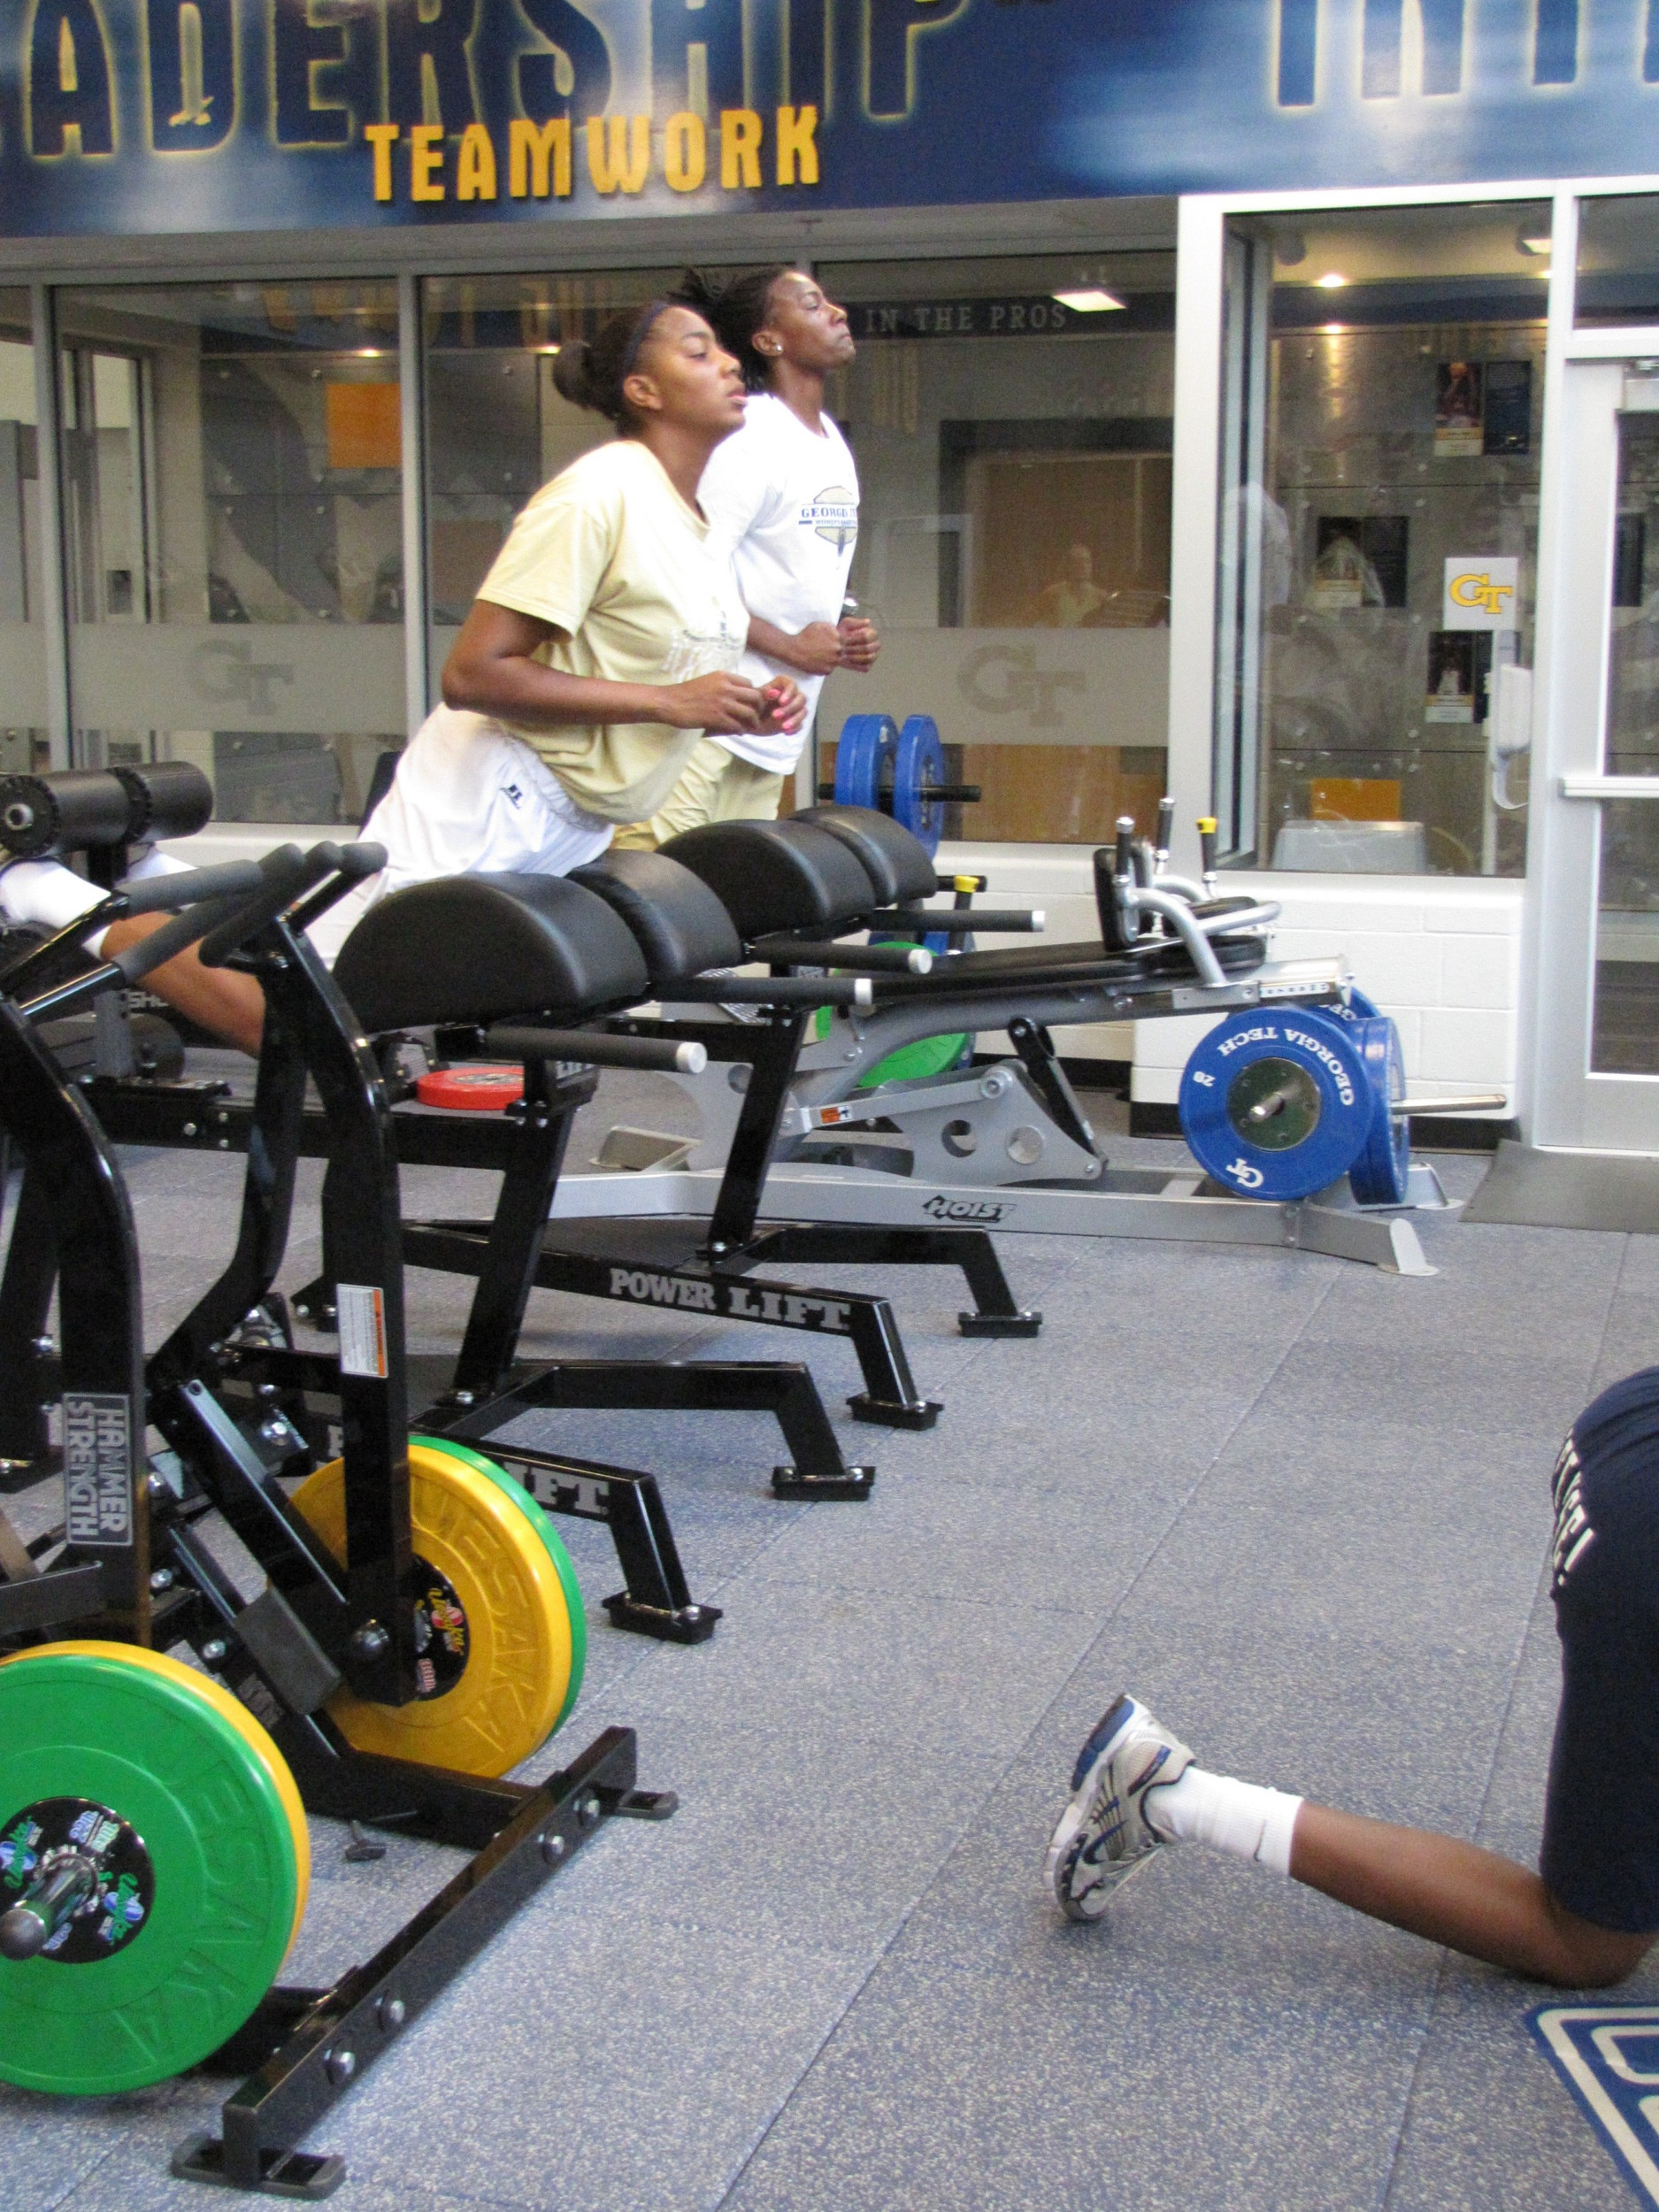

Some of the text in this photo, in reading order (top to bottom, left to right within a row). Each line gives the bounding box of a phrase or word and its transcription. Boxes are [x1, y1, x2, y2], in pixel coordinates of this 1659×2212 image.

[364, 104, 819, 202] TEAMWORK
[865, 304, 1066, 333] IN THE PROS
[1448, 572, 1514, 615] GT
[955, 645, 1087, 728] GT
[1216, 1025, 1356, 1107] GEORGIA TECH
[1225, 1157, 1264, 1188] GT
[923, 1195, 1018, 1223] HOIST
[609, 1267, 851, 1332] POWER LIFT
[66, 1400, 99, 1538] STRENGTH
[92, 1407, 130, 1532] HAMMER
[502, 1460, 611, 1516] IFT
